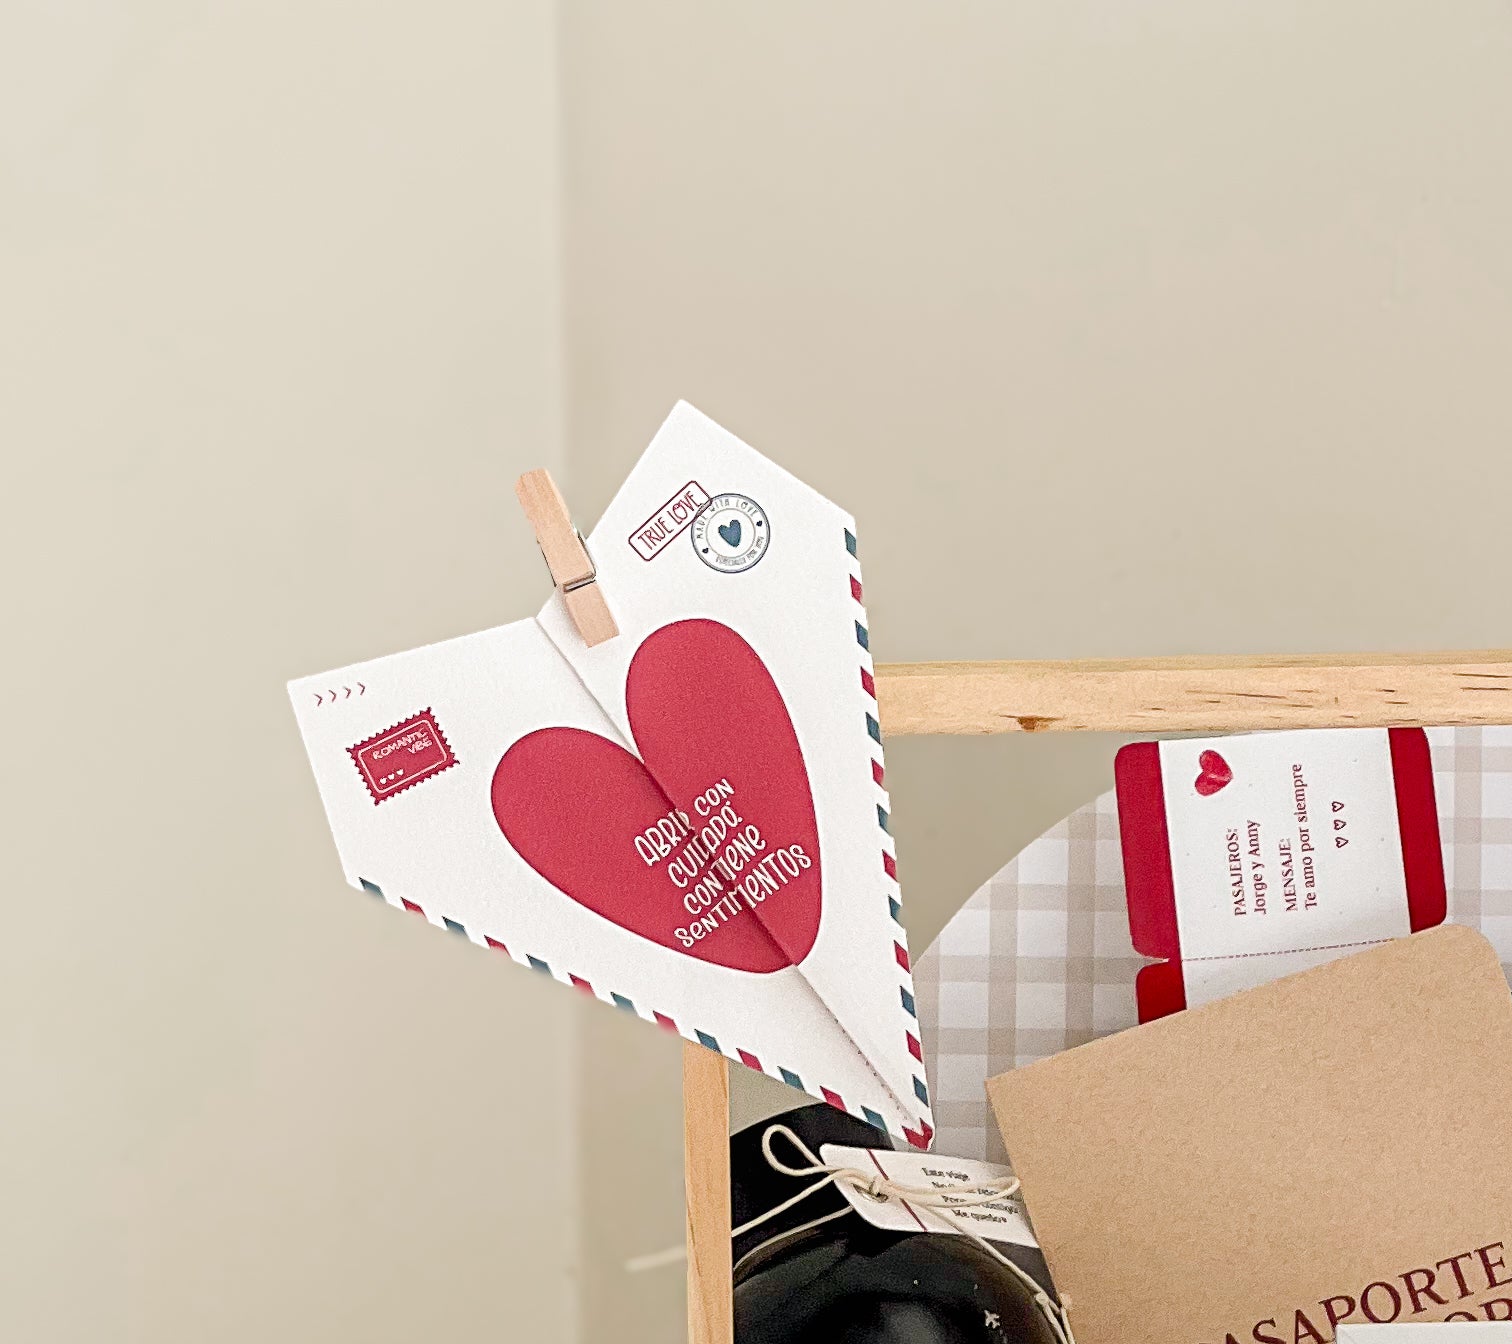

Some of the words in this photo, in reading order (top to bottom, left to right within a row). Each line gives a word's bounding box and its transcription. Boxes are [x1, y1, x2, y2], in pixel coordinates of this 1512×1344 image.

[638, 516, 674, 550] TRUE
[667, 490, 701, 525] LOVE
[694, 779, 734, 816] CON
[1292, 764, 1308, 823] siempre
[1247, 820, 1261, 857] Anny
[1299, 827, 1315, 853] por
[683, 825, 766, 915] CONTIENE
[1226, 828, 1247, 916] PASAJEROS:
[1252, 861, 1265, 871] y
[1279, 838, 1298, 912] MENSAJE:
[1302, 856, 1315, 888] amo
[1252, 873, 1268, 915] Jorge
[1304, 892, 1317, 911] Te
